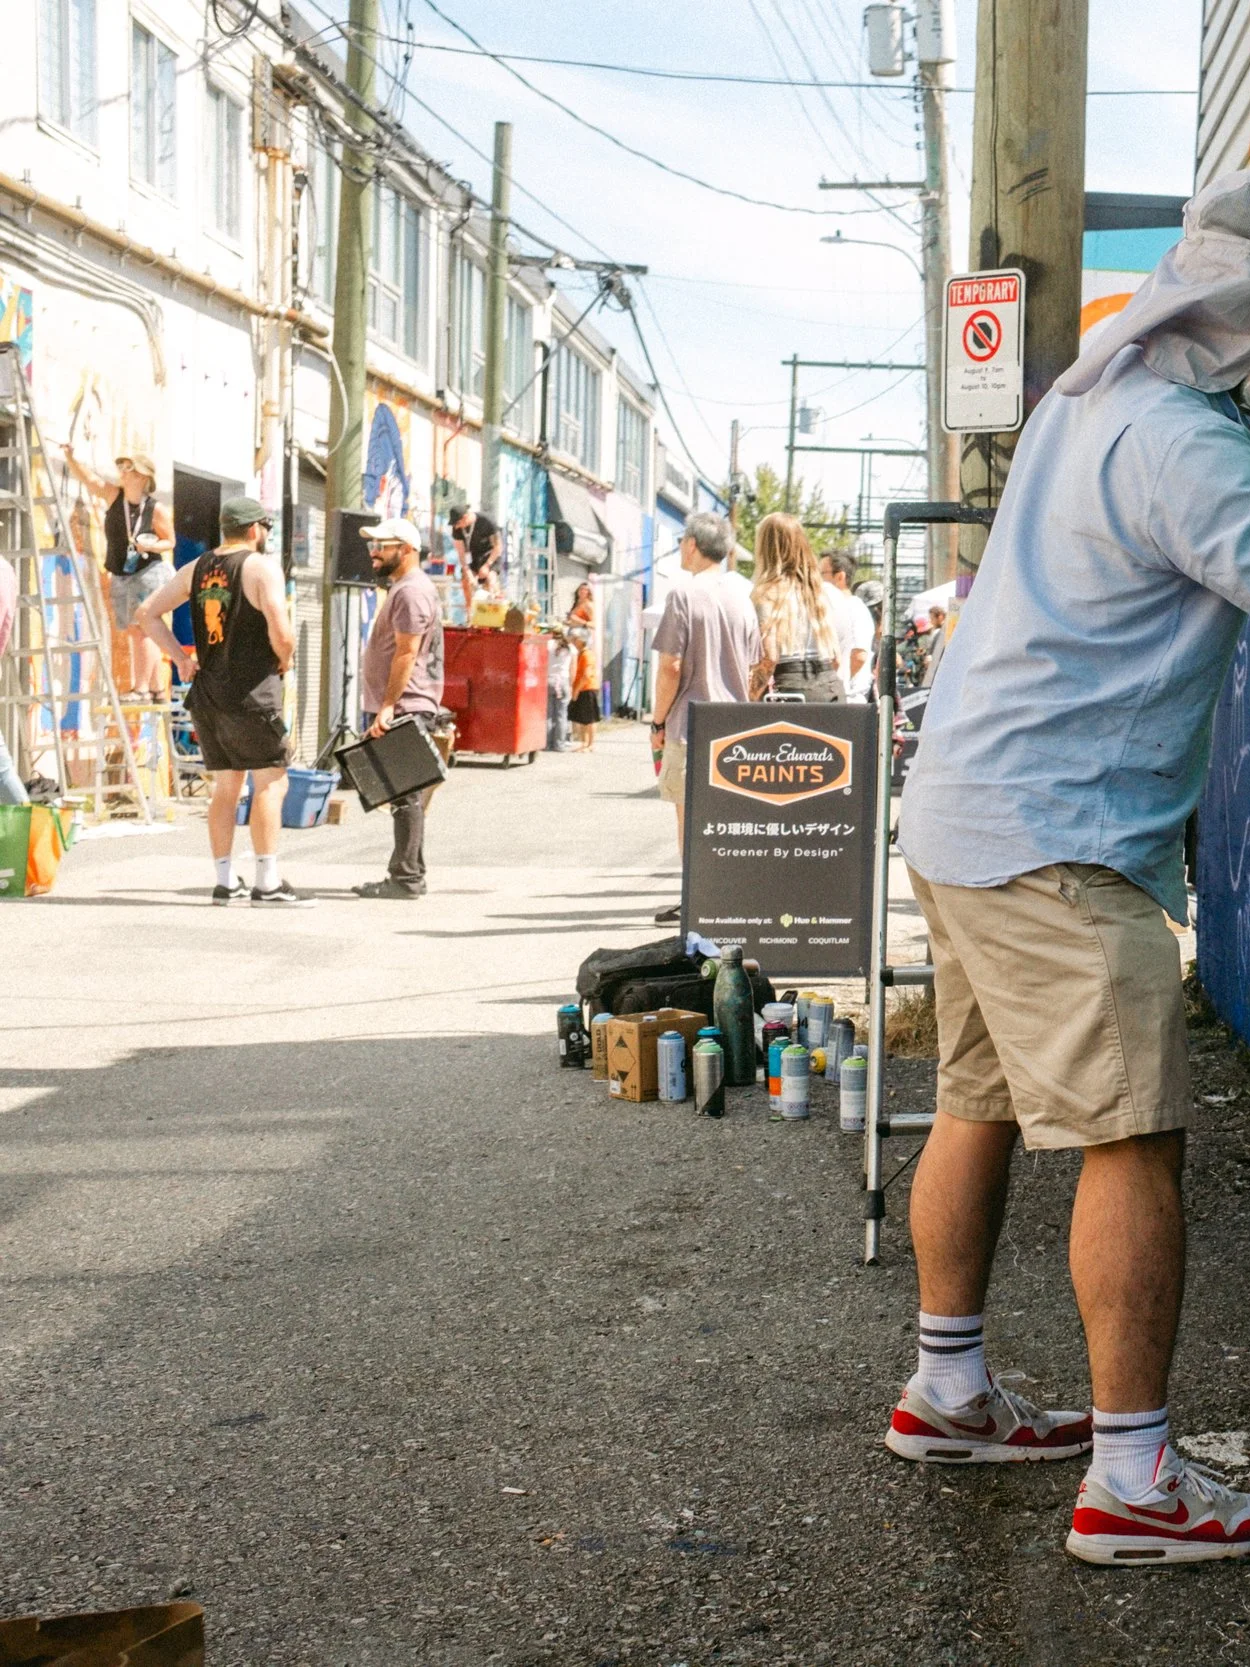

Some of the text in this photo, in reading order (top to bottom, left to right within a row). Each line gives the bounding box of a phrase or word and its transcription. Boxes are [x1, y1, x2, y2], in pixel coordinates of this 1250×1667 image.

[951, 281, 1016, 304] TEMPORARY
[723, 743, 834, 763] Dunn-Edwards
[737, 765, 824, 783] PAINTS
[702, 822, 855, 836] より環境に優しいデザイン
[712, 847, 843, 859] "Greener By Design"
[747, 917, 763, 926] only
[808, 937, 850, 945] COQUITLAM
